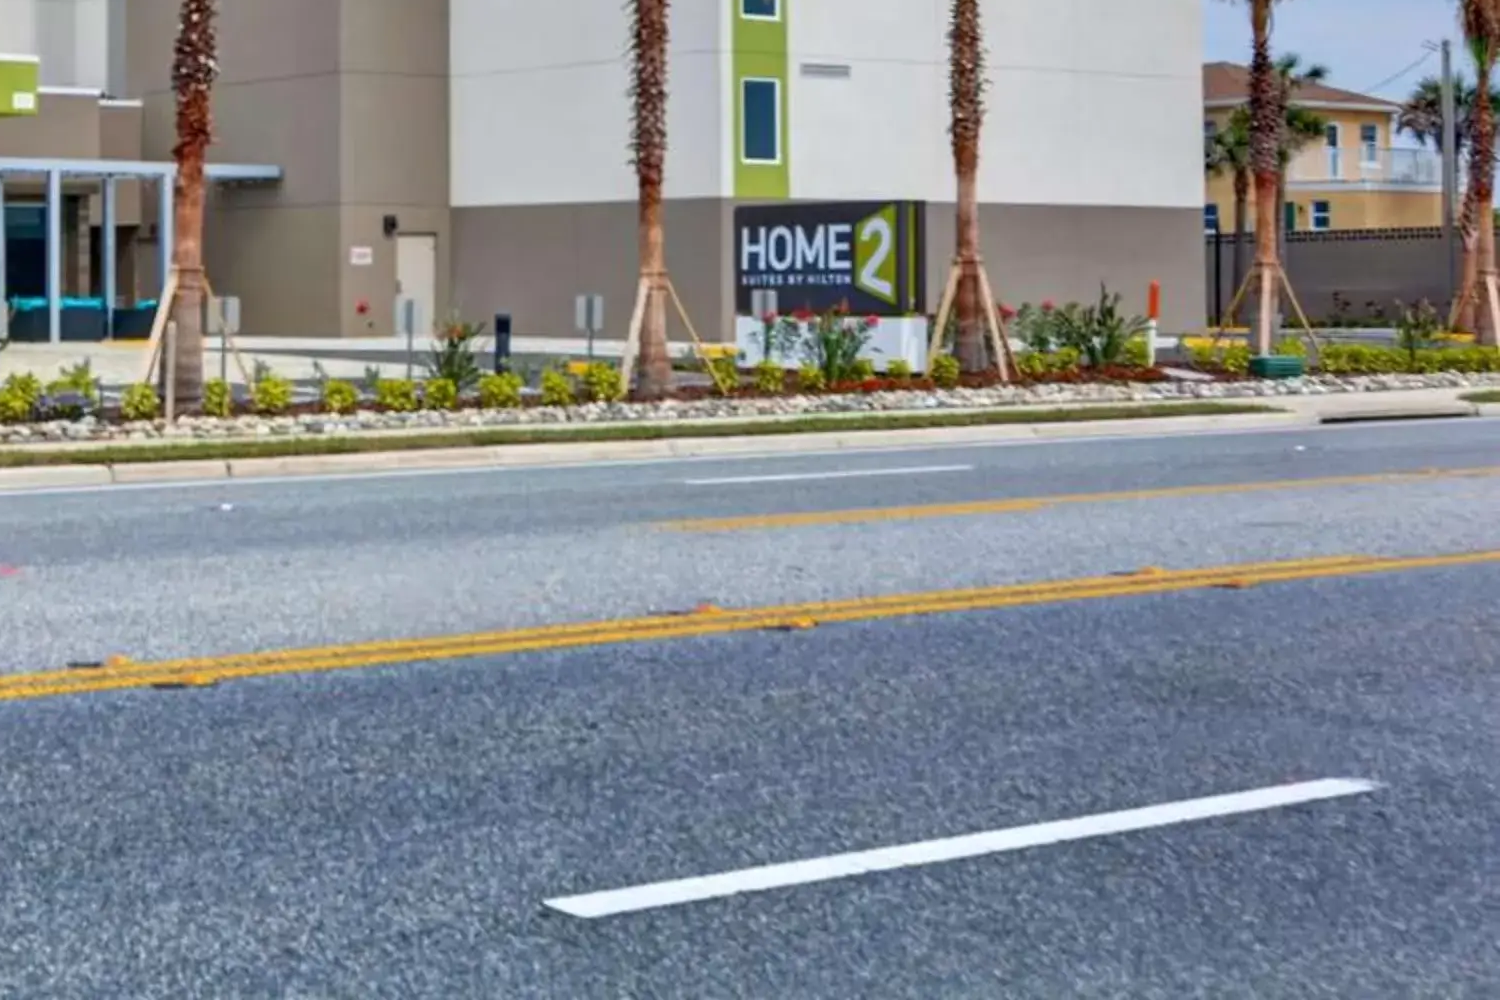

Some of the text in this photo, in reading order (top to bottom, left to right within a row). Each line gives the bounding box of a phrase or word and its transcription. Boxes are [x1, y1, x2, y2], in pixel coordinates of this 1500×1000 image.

[741, 217, 892, 296] HOME 2
[742, 274, 783, 286] SUITES
[807, 274, 852, 285] HILTON
